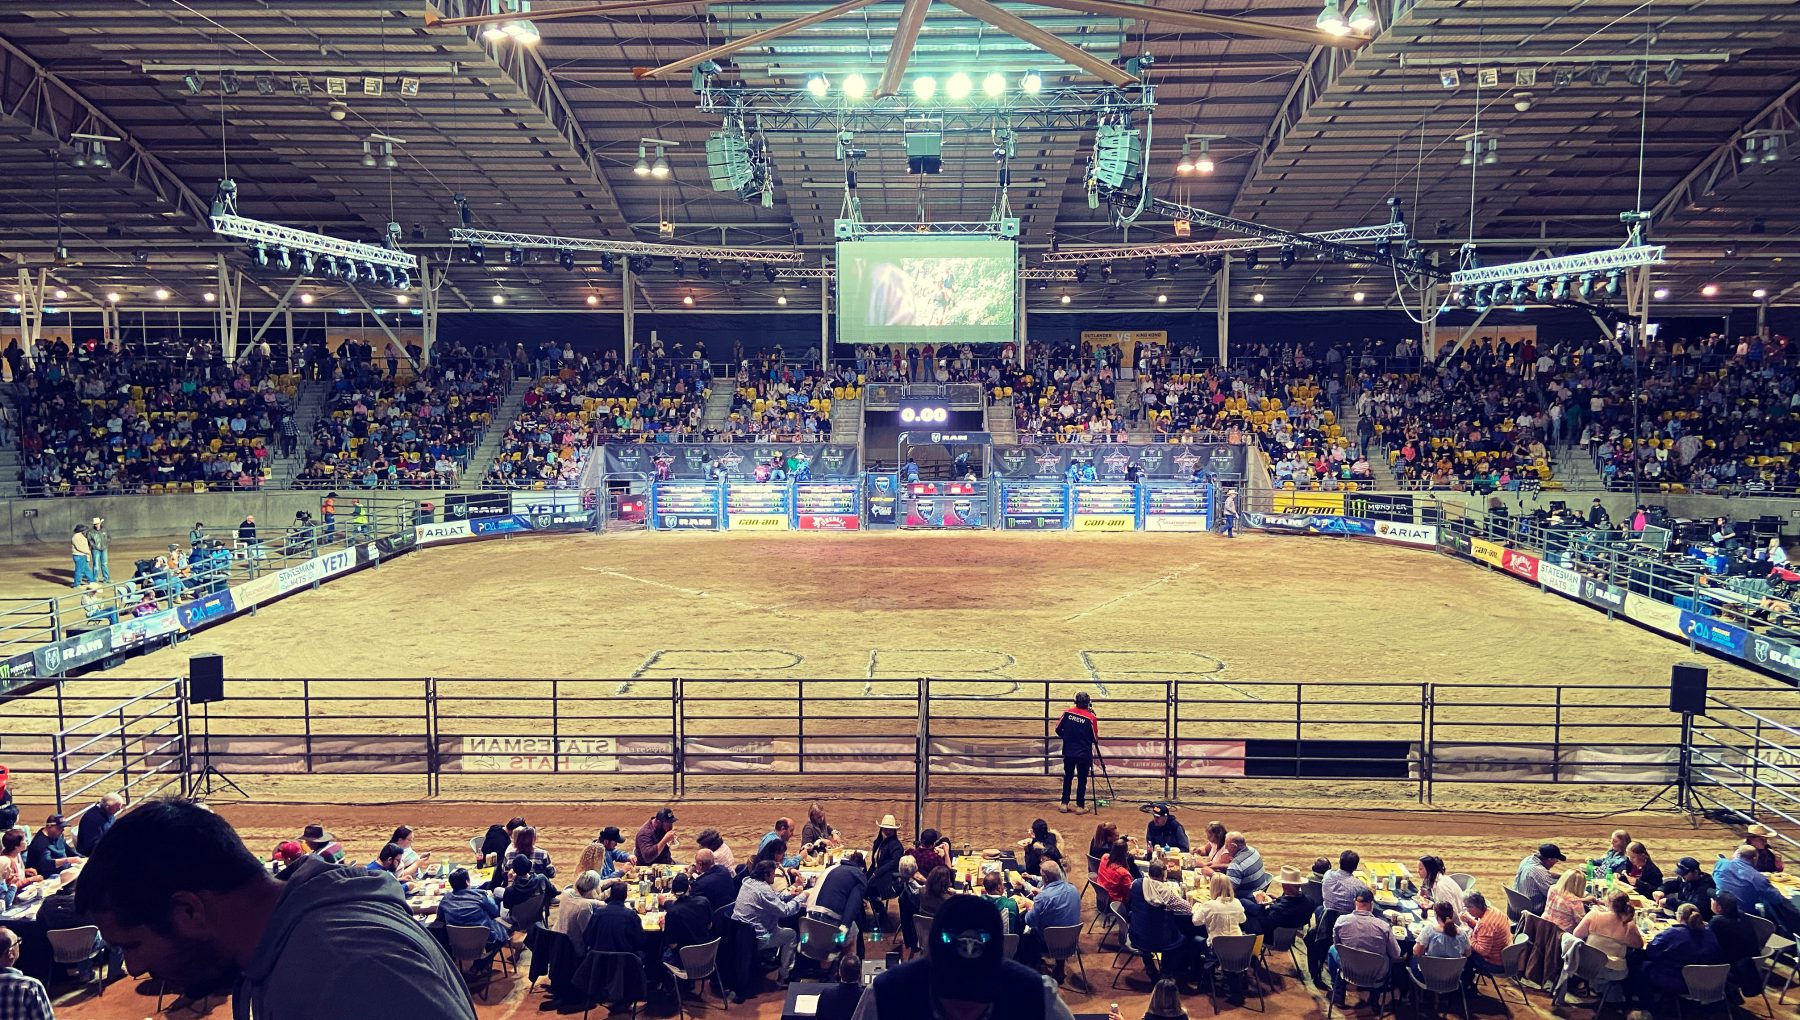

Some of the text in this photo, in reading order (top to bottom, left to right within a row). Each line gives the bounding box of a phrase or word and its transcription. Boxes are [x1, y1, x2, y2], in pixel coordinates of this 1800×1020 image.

[1117, 332, 1131, 342] VS
[901, 407, 947, 422] 0.00
[469, 506, 503, 514] RAM
[524, 503, 565, 514] YETI
[1283, 506, 1336, 514] can-am
[1368, 503, 1407, 511] MONSTER
[553, 515, 588, 524] RAM
[679, 517, 712, 526] RAM
[1265, 517, 1303, 526] RAM
[1321, 519, 1347, 529] POA
[425, 526, 465, 537] ARIAT
[478, 522, 497, 532] POA
[1389, 529, 1430, 539] ARIAT
[1474, 546, 1498, 559] can-am
[322, 552, 348, 573] YETI
[1540, 564, 1579, 585] STATESMAN
[1549, 577, 1567, 590] HATS
[1595, 588, 1621, 604] RAM
[184, 607, 205, 624] POA
[1687, 619, 1709, 640] POA
[62, 638, 104, 660] RAM
[1067, 714, 1086, 724] CREW
